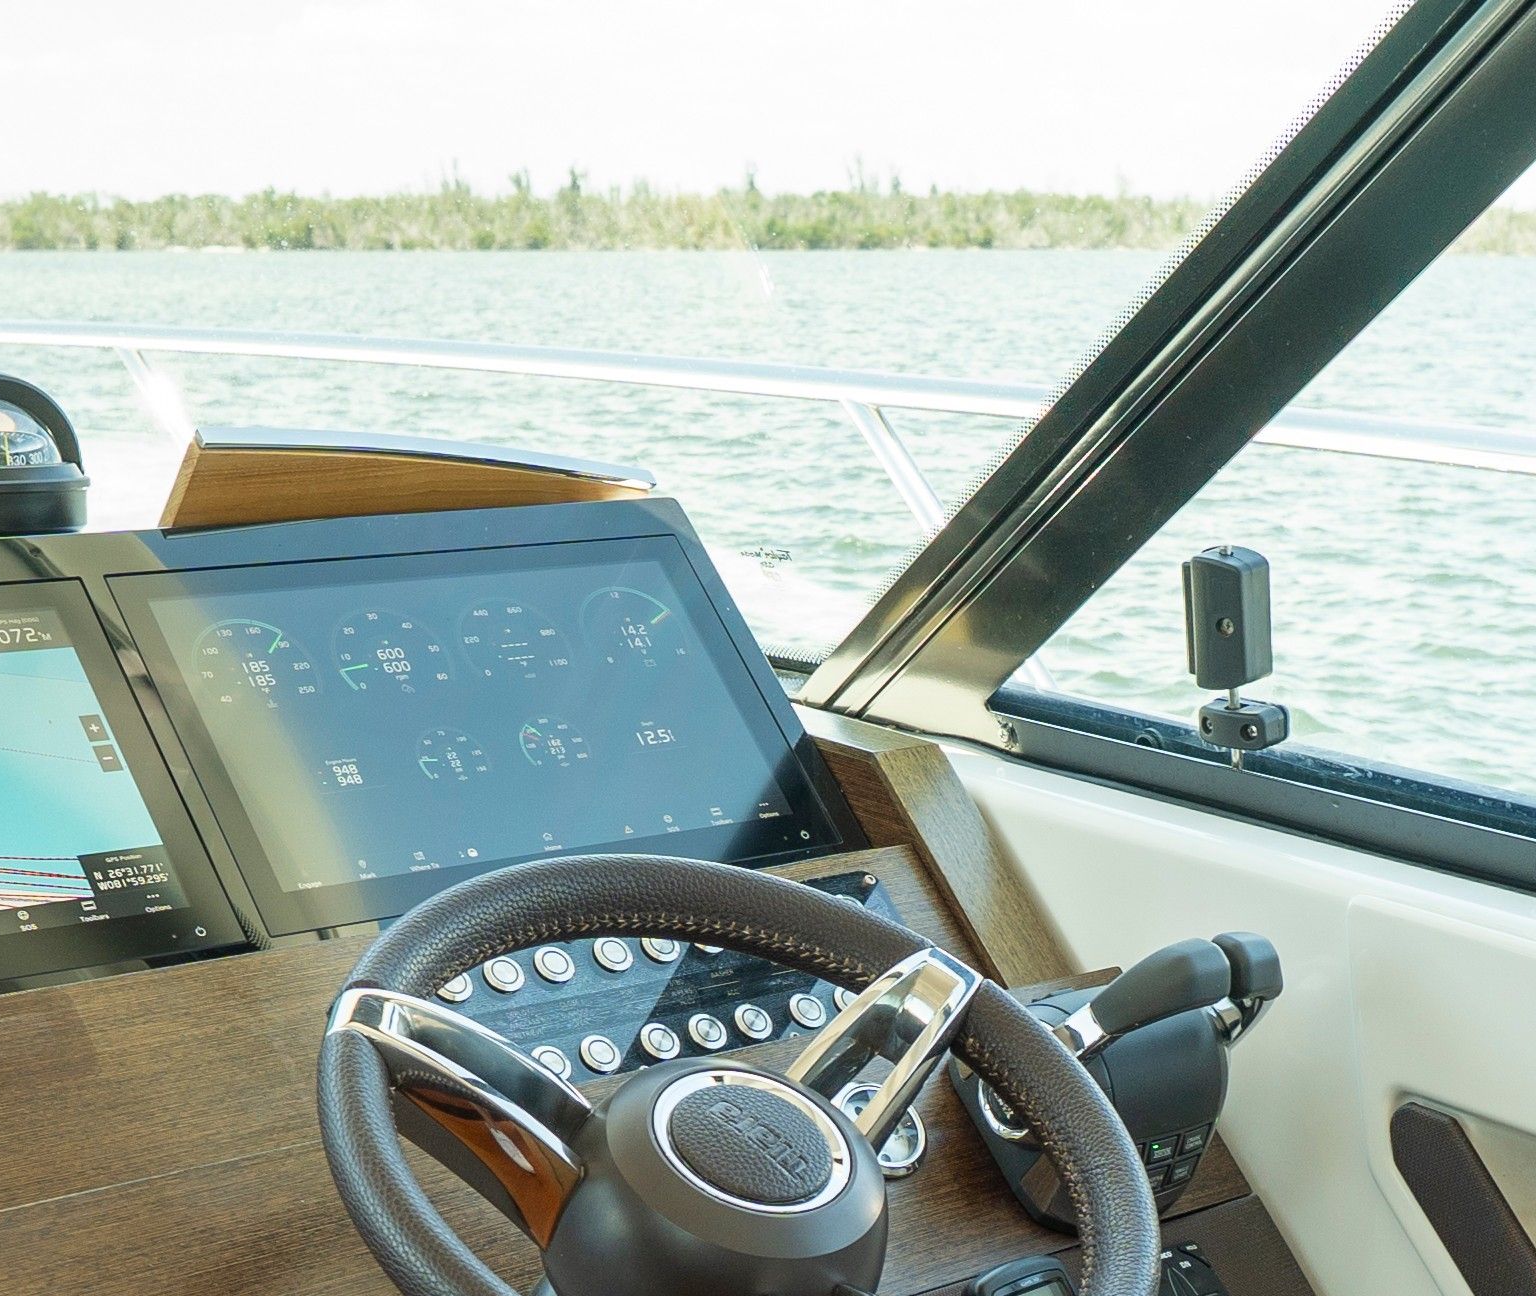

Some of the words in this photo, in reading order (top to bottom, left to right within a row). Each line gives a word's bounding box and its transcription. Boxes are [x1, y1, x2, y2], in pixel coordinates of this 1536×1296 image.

[216, 629, 233, 637] 130
[621, 624, 647, 636] 14.2
[202, 647, 219, 655] 100
[377, 647, 405, 661] 600
[242, 660, 270, 674] 185
[383, 661, 411, 674] 600
[201, 671, 214, 679] 70
[248, 674, 276, 687] 185
[360, 682, 367, 690] 0
[636, 729, 671, 746] 12.5
[332, 764, 359, 776] 948
[337, 775, 363, 787] 948
[93, 871, 103, 881] N
[145, 904, 172, 914] Options
[79, 913, 111, 924] Toolbars
[19, 923, 38, 932] SOS
